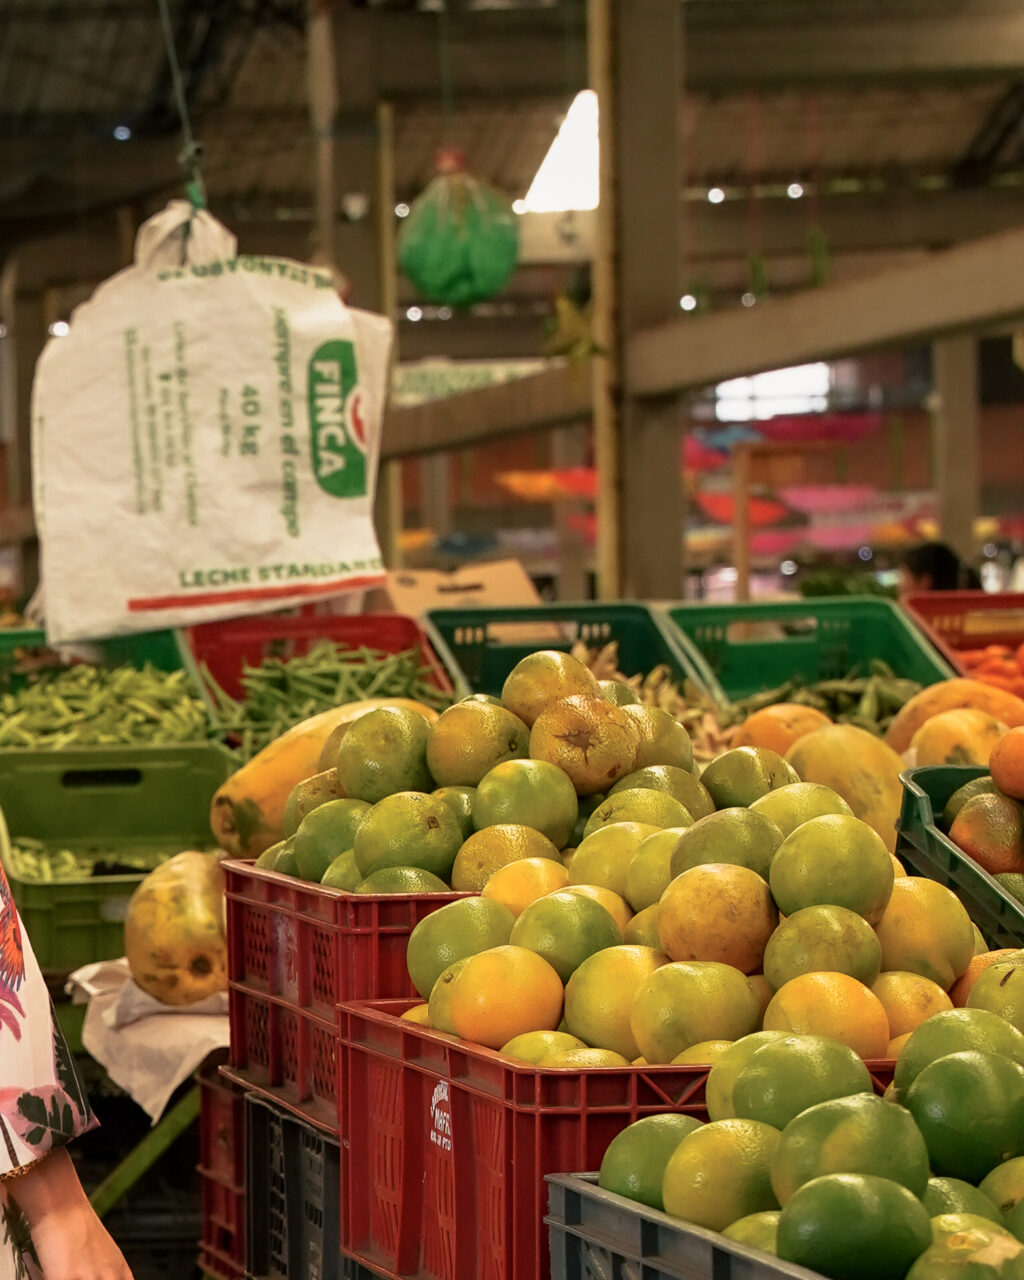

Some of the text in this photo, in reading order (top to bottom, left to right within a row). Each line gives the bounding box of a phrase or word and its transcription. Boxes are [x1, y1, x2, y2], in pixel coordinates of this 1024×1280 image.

[238, 384, 260, 457] 40 kg
[280, 434, 299, 456] el
[313, 359, 347, 478] FINCA
[279, 460, 299, 539] campo
[179, 567, 250, 587] LECHE
